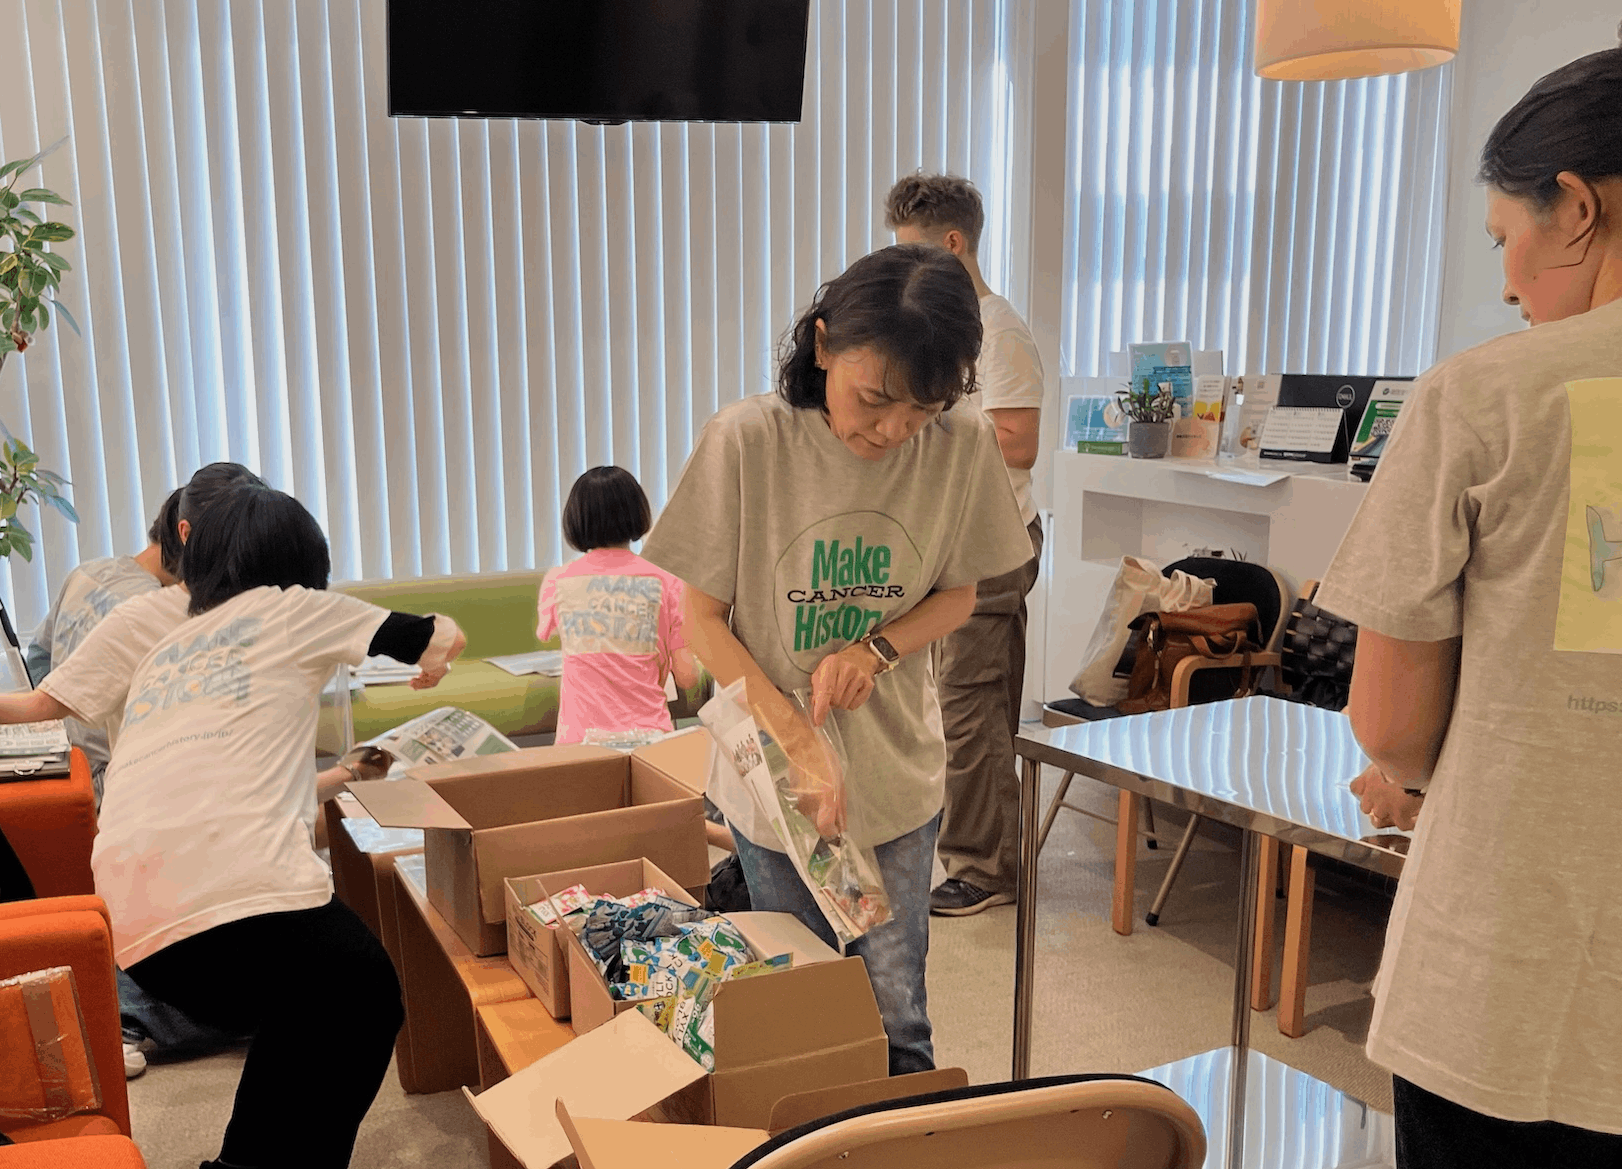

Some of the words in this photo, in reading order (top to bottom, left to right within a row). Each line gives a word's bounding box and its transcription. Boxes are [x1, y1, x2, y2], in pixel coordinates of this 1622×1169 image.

[811, 536, 891, 589] Make
[787, 585, 904, 603] CANCER
[794, 603, 882, 651] Histor
